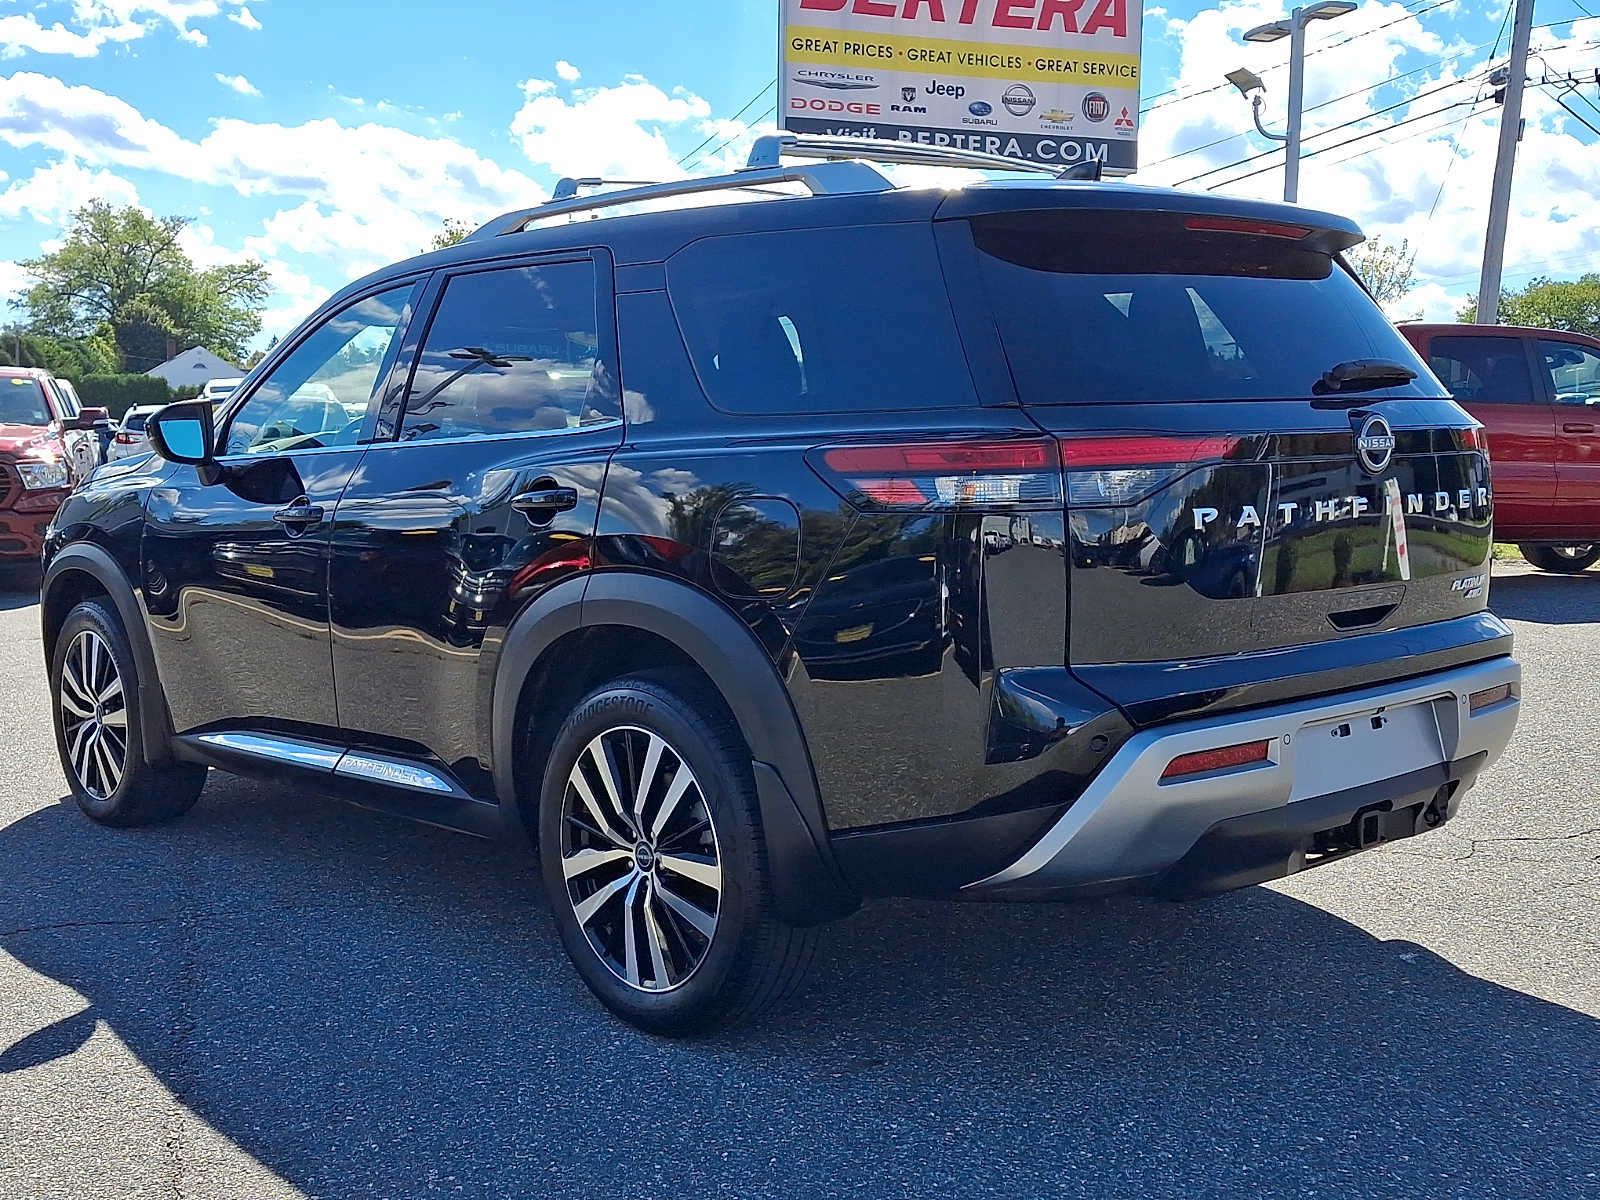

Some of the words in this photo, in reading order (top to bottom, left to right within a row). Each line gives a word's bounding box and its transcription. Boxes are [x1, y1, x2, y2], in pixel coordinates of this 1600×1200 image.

[791, 38, 839, 54] GREAT
[843, 42, 893, 59] PRICES
[907, 48, 953, 64] GREAT
[957, 52, 1022, 69] VEHICLES
[1035, 58, 1079, 73] GREAT
[1082, 62, 1137, 78] SERVICE
[797, 70, 875, 82] CHRYSLER
[925, 80, 965, 99] Jeep
[791, 98, 881, 116] DODGE
[1003, 96, 1034, 106] NISSAN
[890, 104, 927, 115] RAM
[1089, 101, 1104, 115] FIAT
[962, 117, 998, 126] SUBARU
[1358, 437, 1395, 449] NISSAN
[1192, 487, 1489, 530] PATHFINDER
